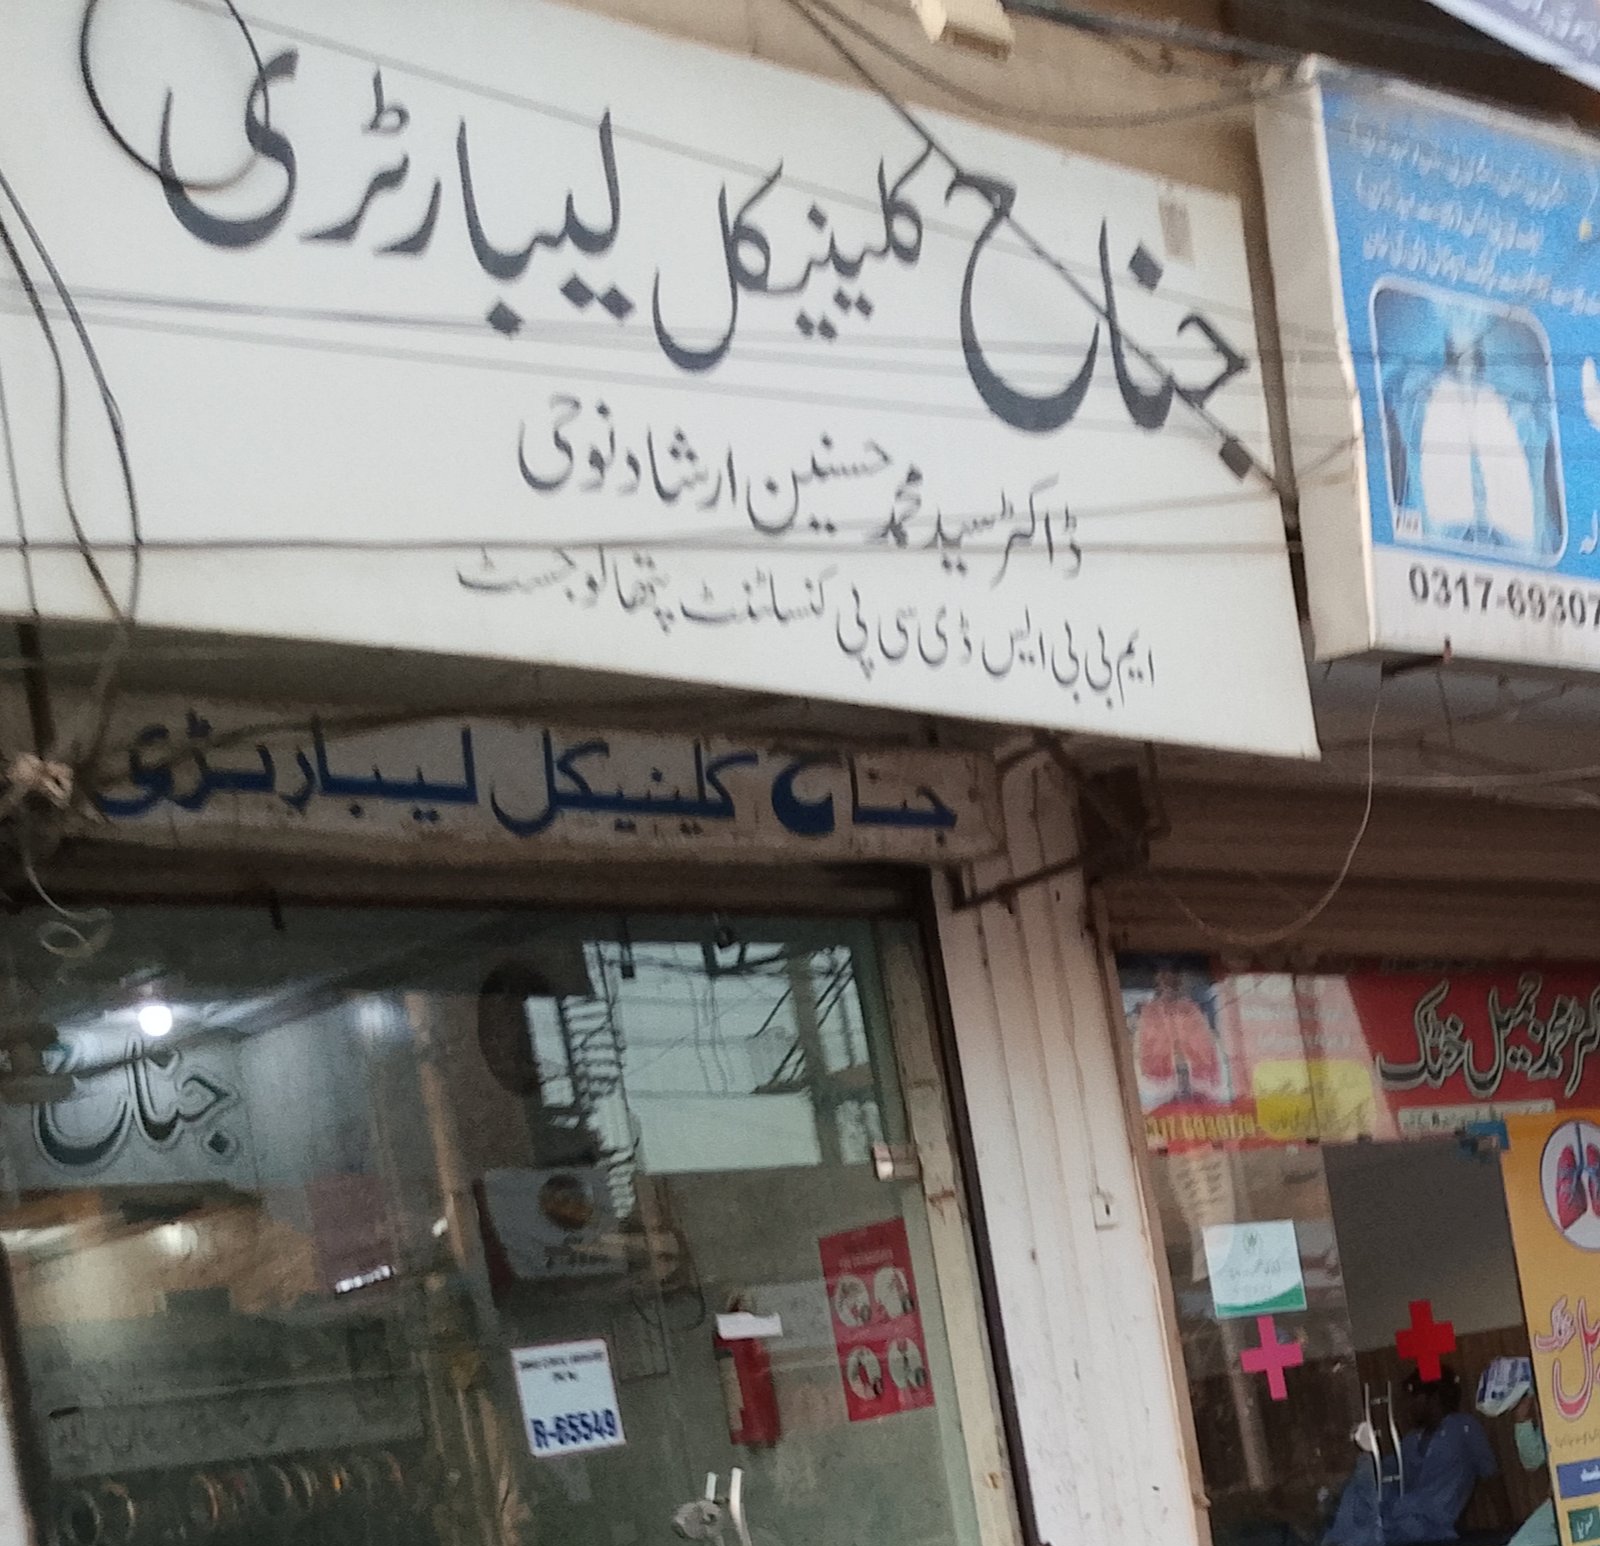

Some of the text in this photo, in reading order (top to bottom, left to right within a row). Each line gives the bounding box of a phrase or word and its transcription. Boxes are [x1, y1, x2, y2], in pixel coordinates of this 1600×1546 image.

[159, 48, 1253, 479] جناح کلینیکل لیبارٹری
[923, 508, 996, 574] سید
[990, 472, 1082, 589] ڈاکٹر
[1050, 618, 1080, 704] بی
[1084, 625, 1113, 710] بی
[770, 750, 958, 846] جناح
